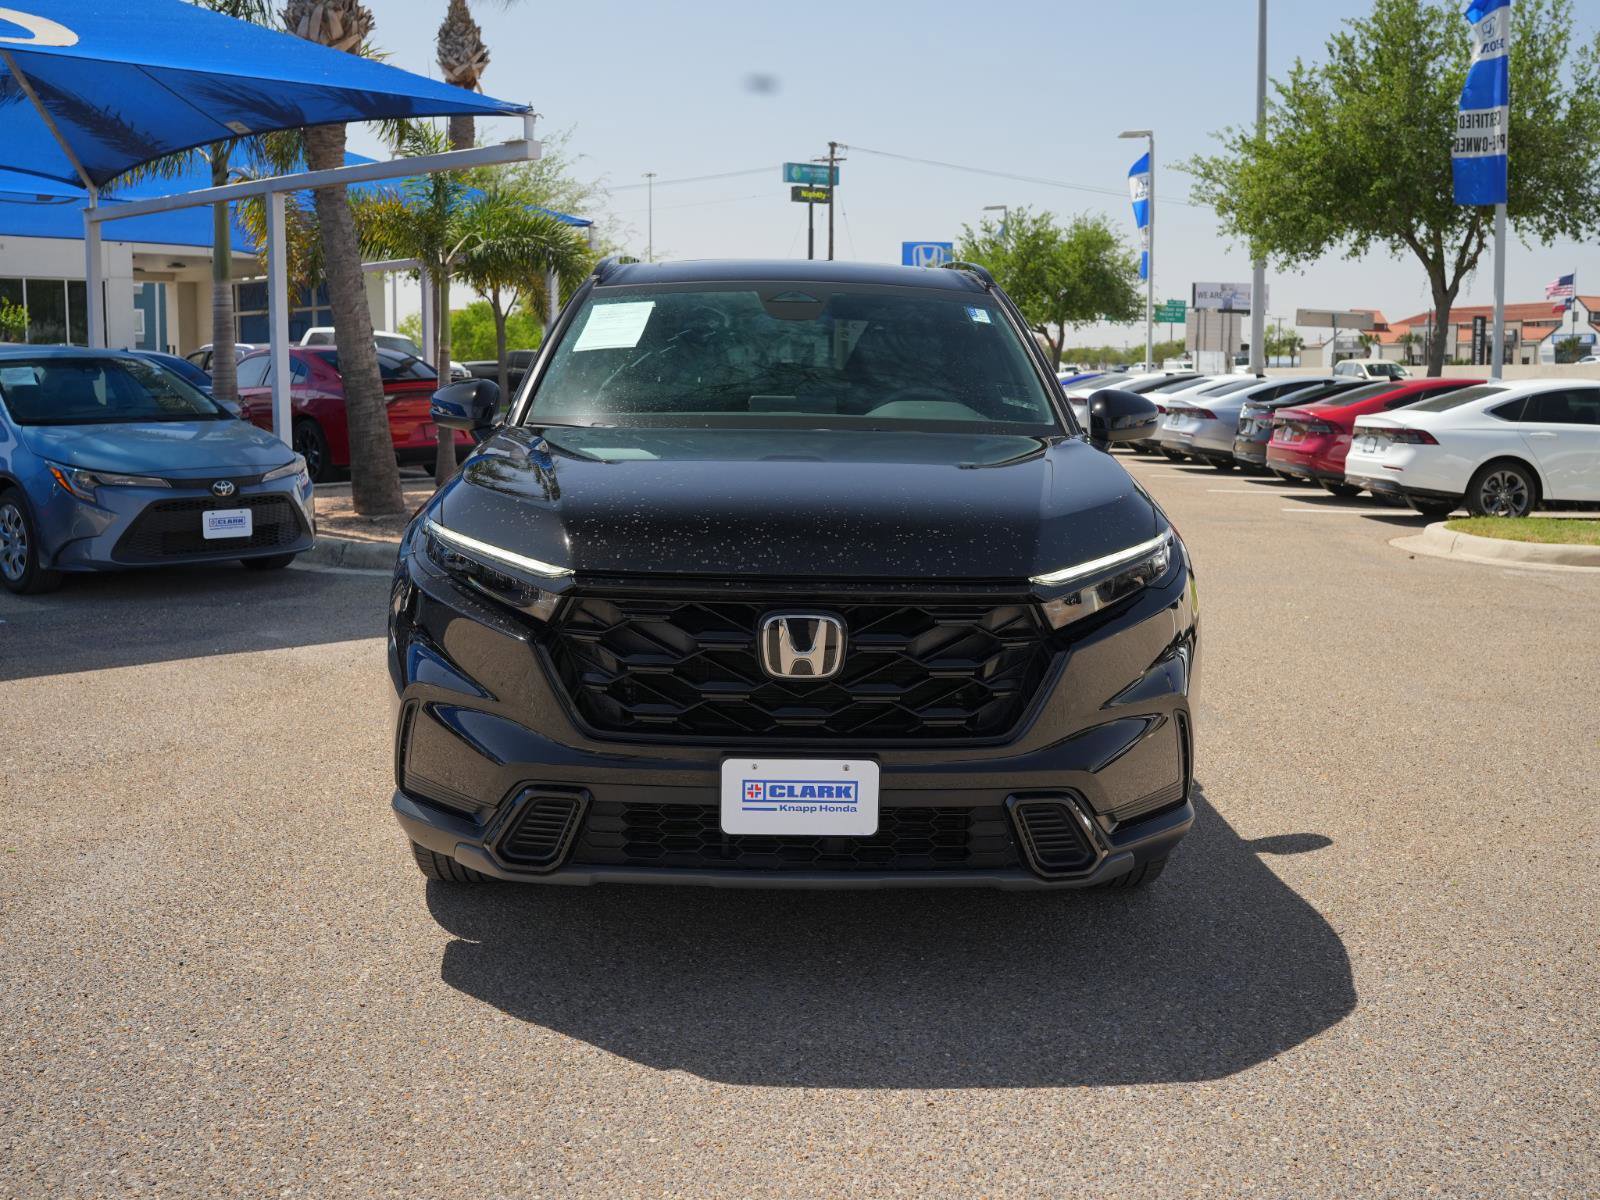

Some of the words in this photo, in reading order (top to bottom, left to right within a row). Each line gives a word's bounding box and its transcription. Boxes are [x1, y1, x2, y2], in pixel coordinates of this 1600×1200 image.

[769, 784, 852, 799] CLARK
[779, 804, 817, 813] Knapp
[819, 804, 858, 813] Honda
